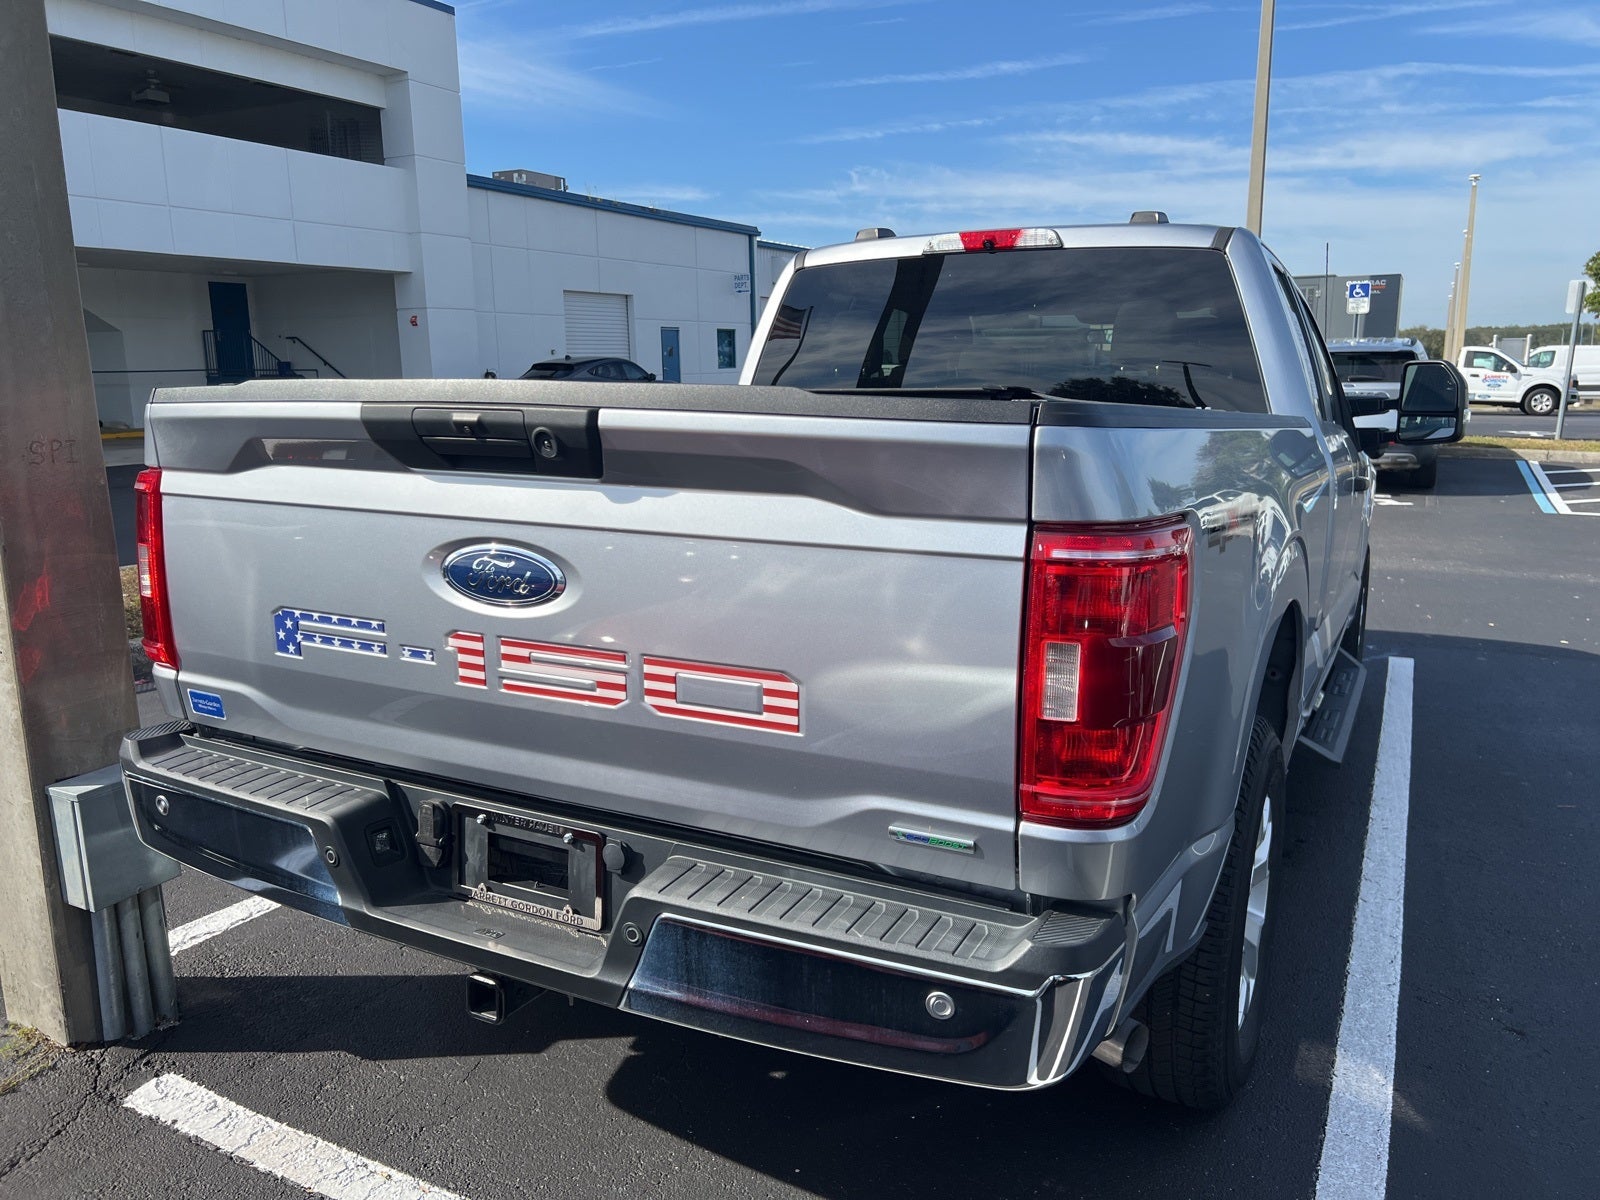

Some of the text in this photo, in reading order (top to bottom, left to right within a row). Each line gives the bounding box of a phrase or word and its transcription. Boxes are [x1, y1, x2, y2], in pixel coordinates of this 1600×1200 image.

[466, 556, 532, 596] Ford
[273, 606, 803, 736] F-150
[510, 900, 554, 919] GORDON
[556, 911, 584, 926] FORD
